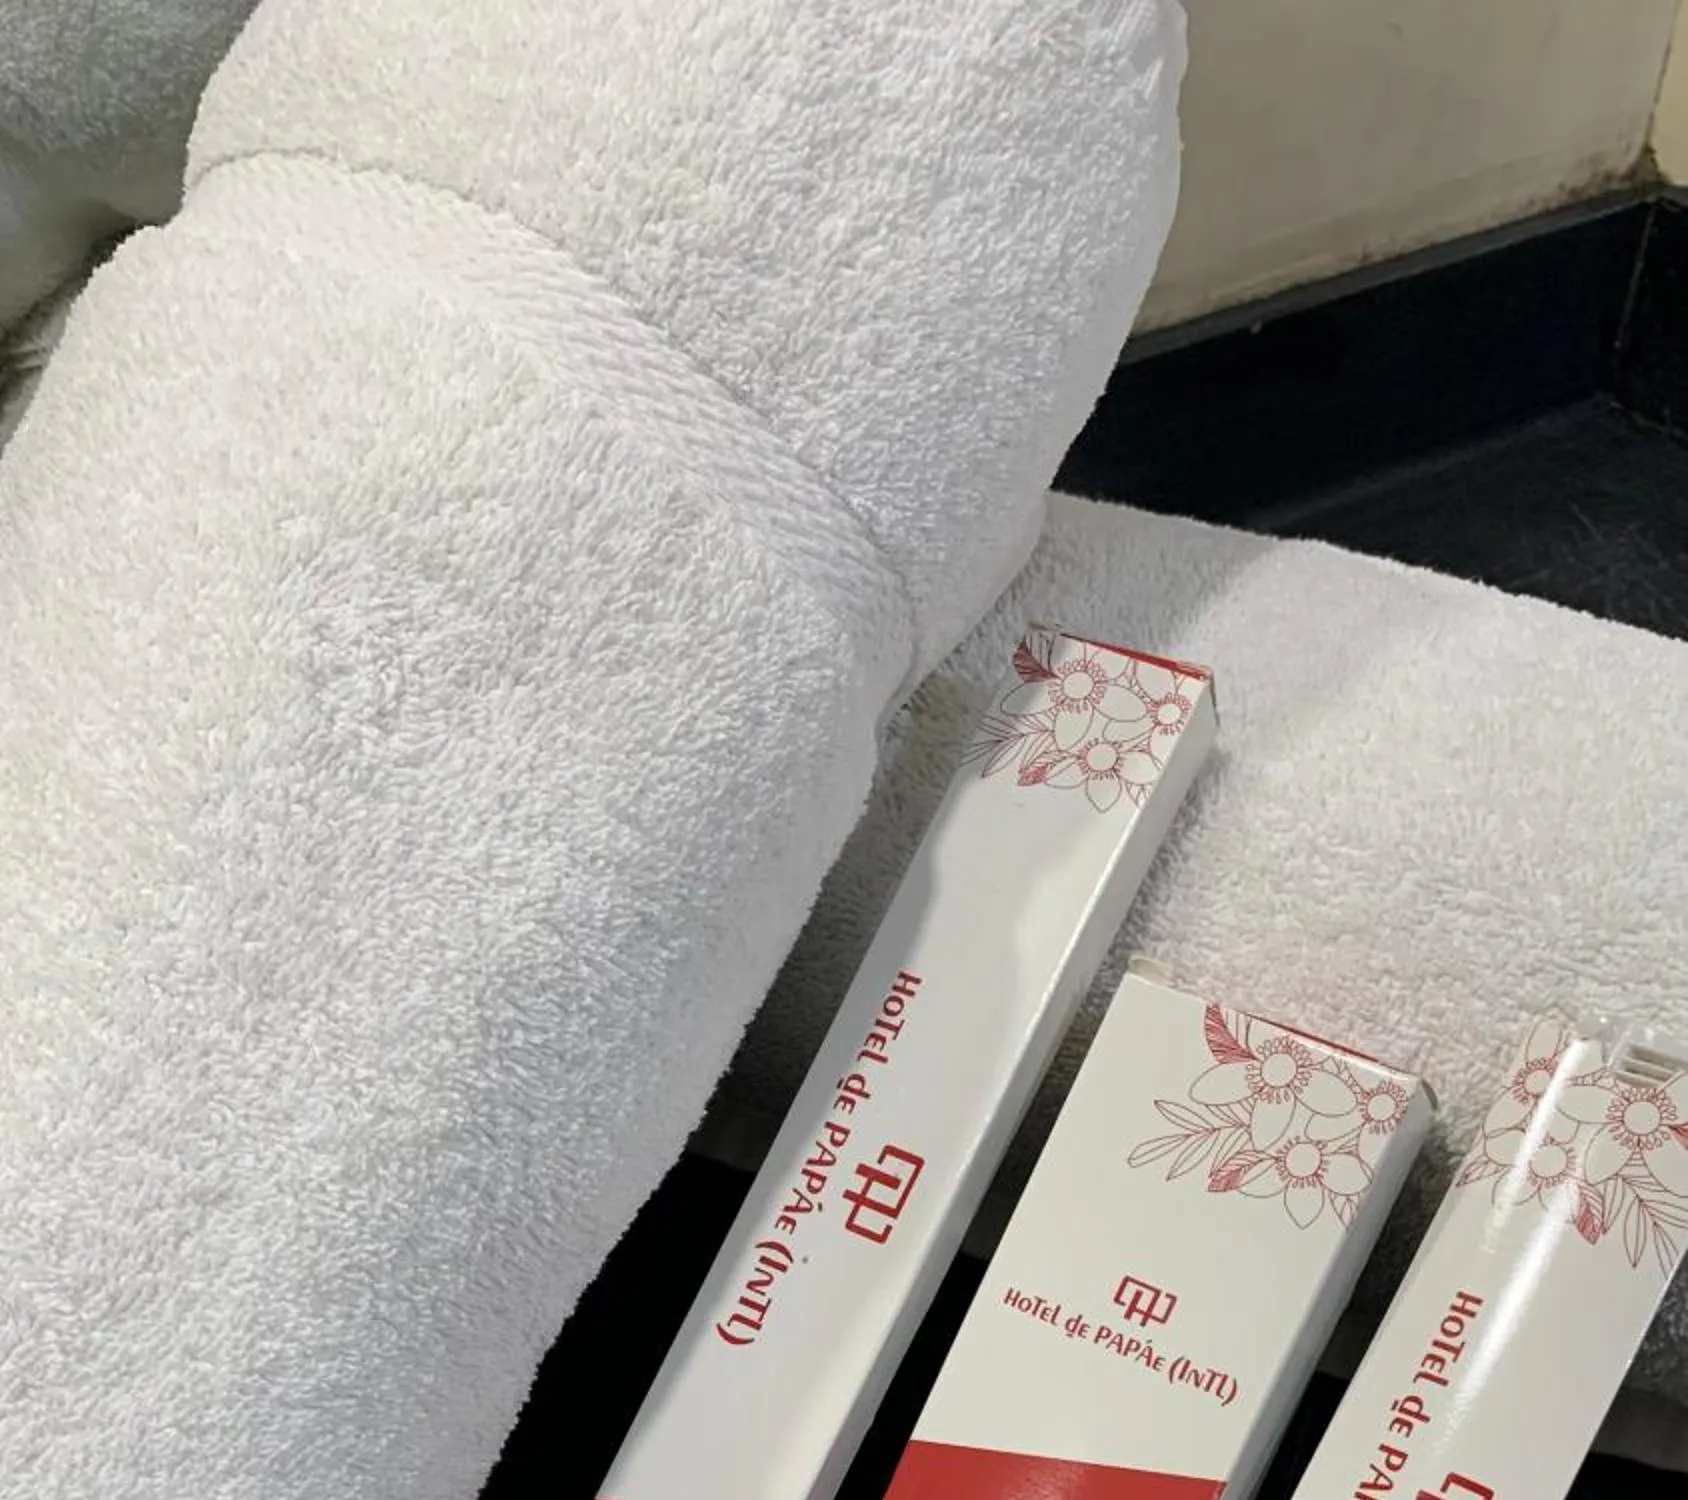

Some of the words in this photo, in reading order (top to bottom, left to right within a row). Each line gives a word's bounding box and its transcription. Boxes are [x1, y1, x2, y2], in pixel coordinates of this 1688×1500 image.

[836, 1073, 870, 1116] de
[1064, 1314, 1091, 1339] de
[1388, 1394, 1431, 1438] de
